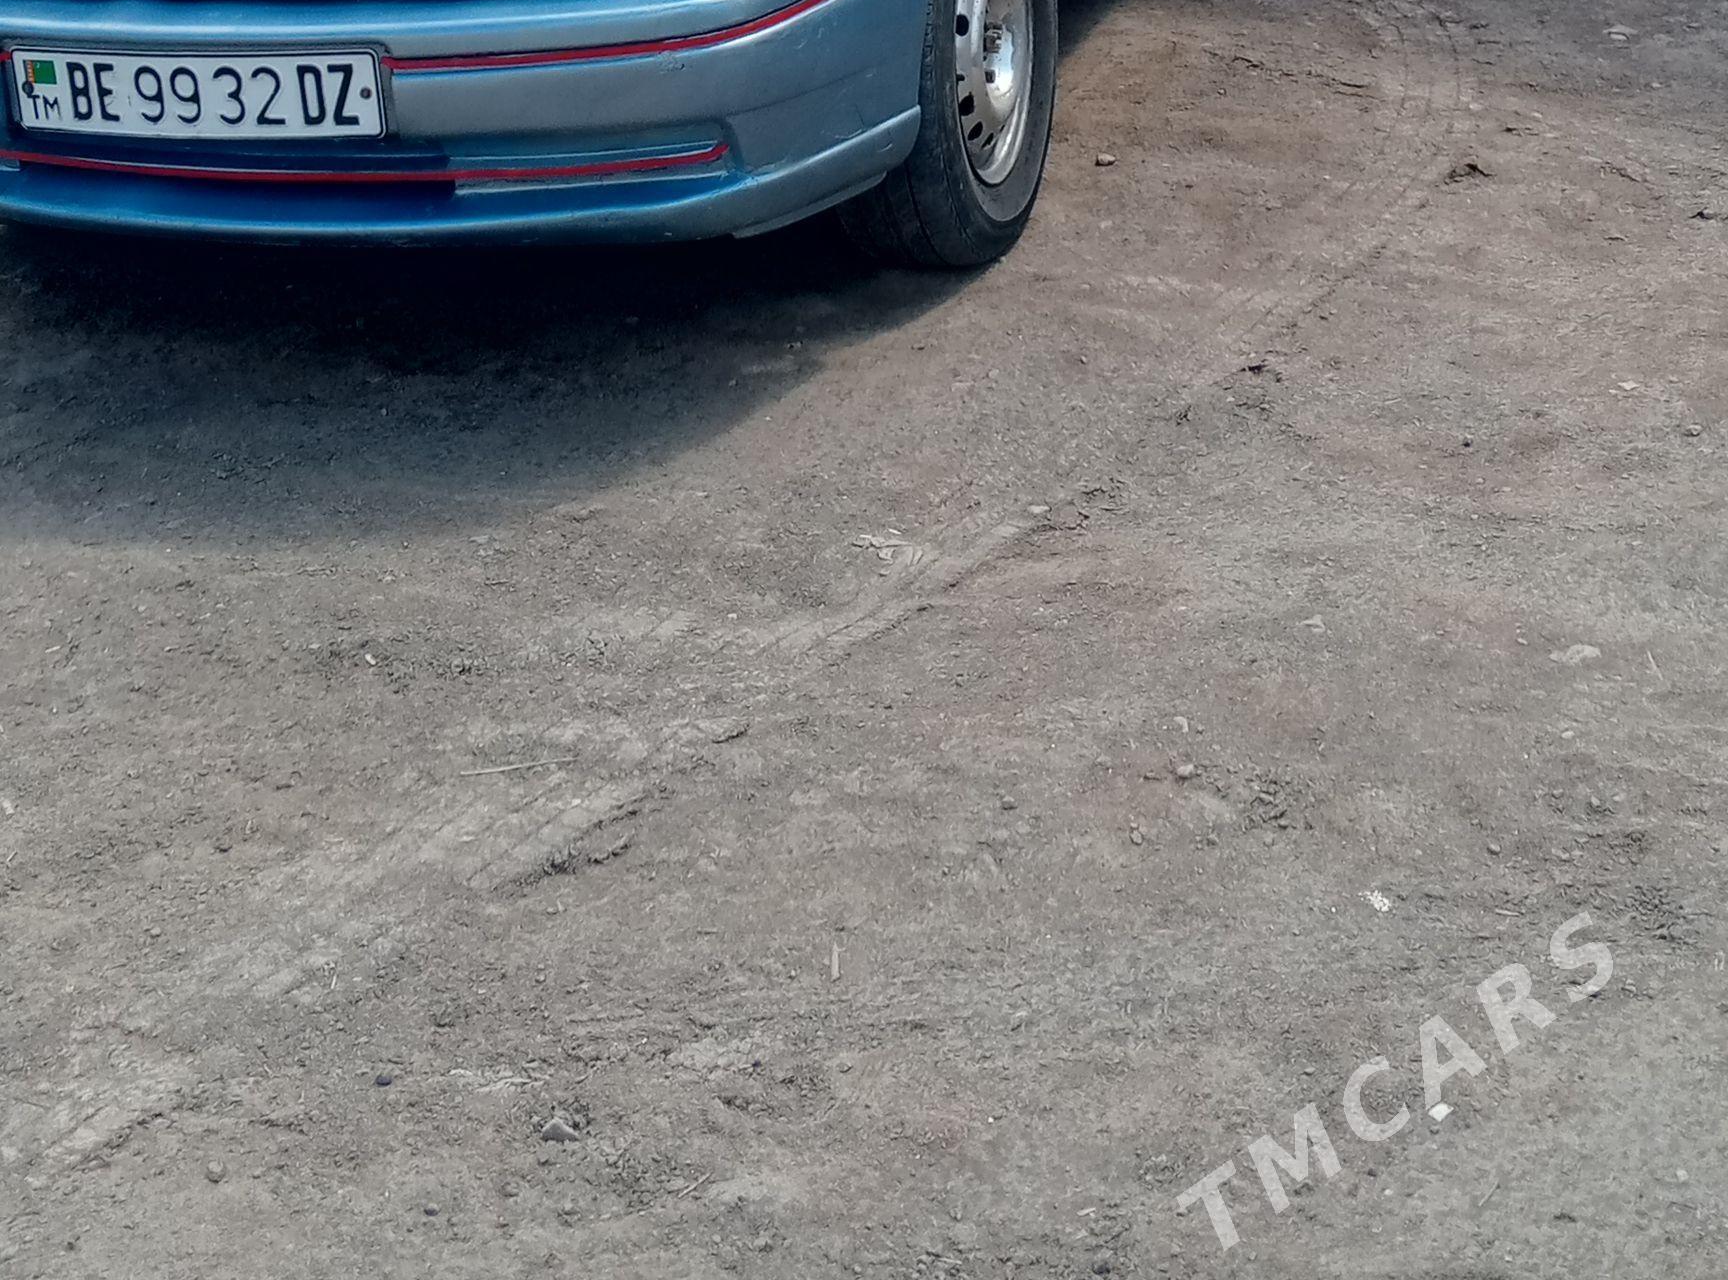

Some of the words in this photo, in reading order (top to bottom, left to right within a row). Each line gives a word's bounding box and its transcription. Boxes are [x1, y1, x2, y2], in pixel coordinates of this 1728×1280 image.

[30, 93, 62, 121] TM
[66, 61, 120, 122] BE
[296, 63, 360, 126] DZ
